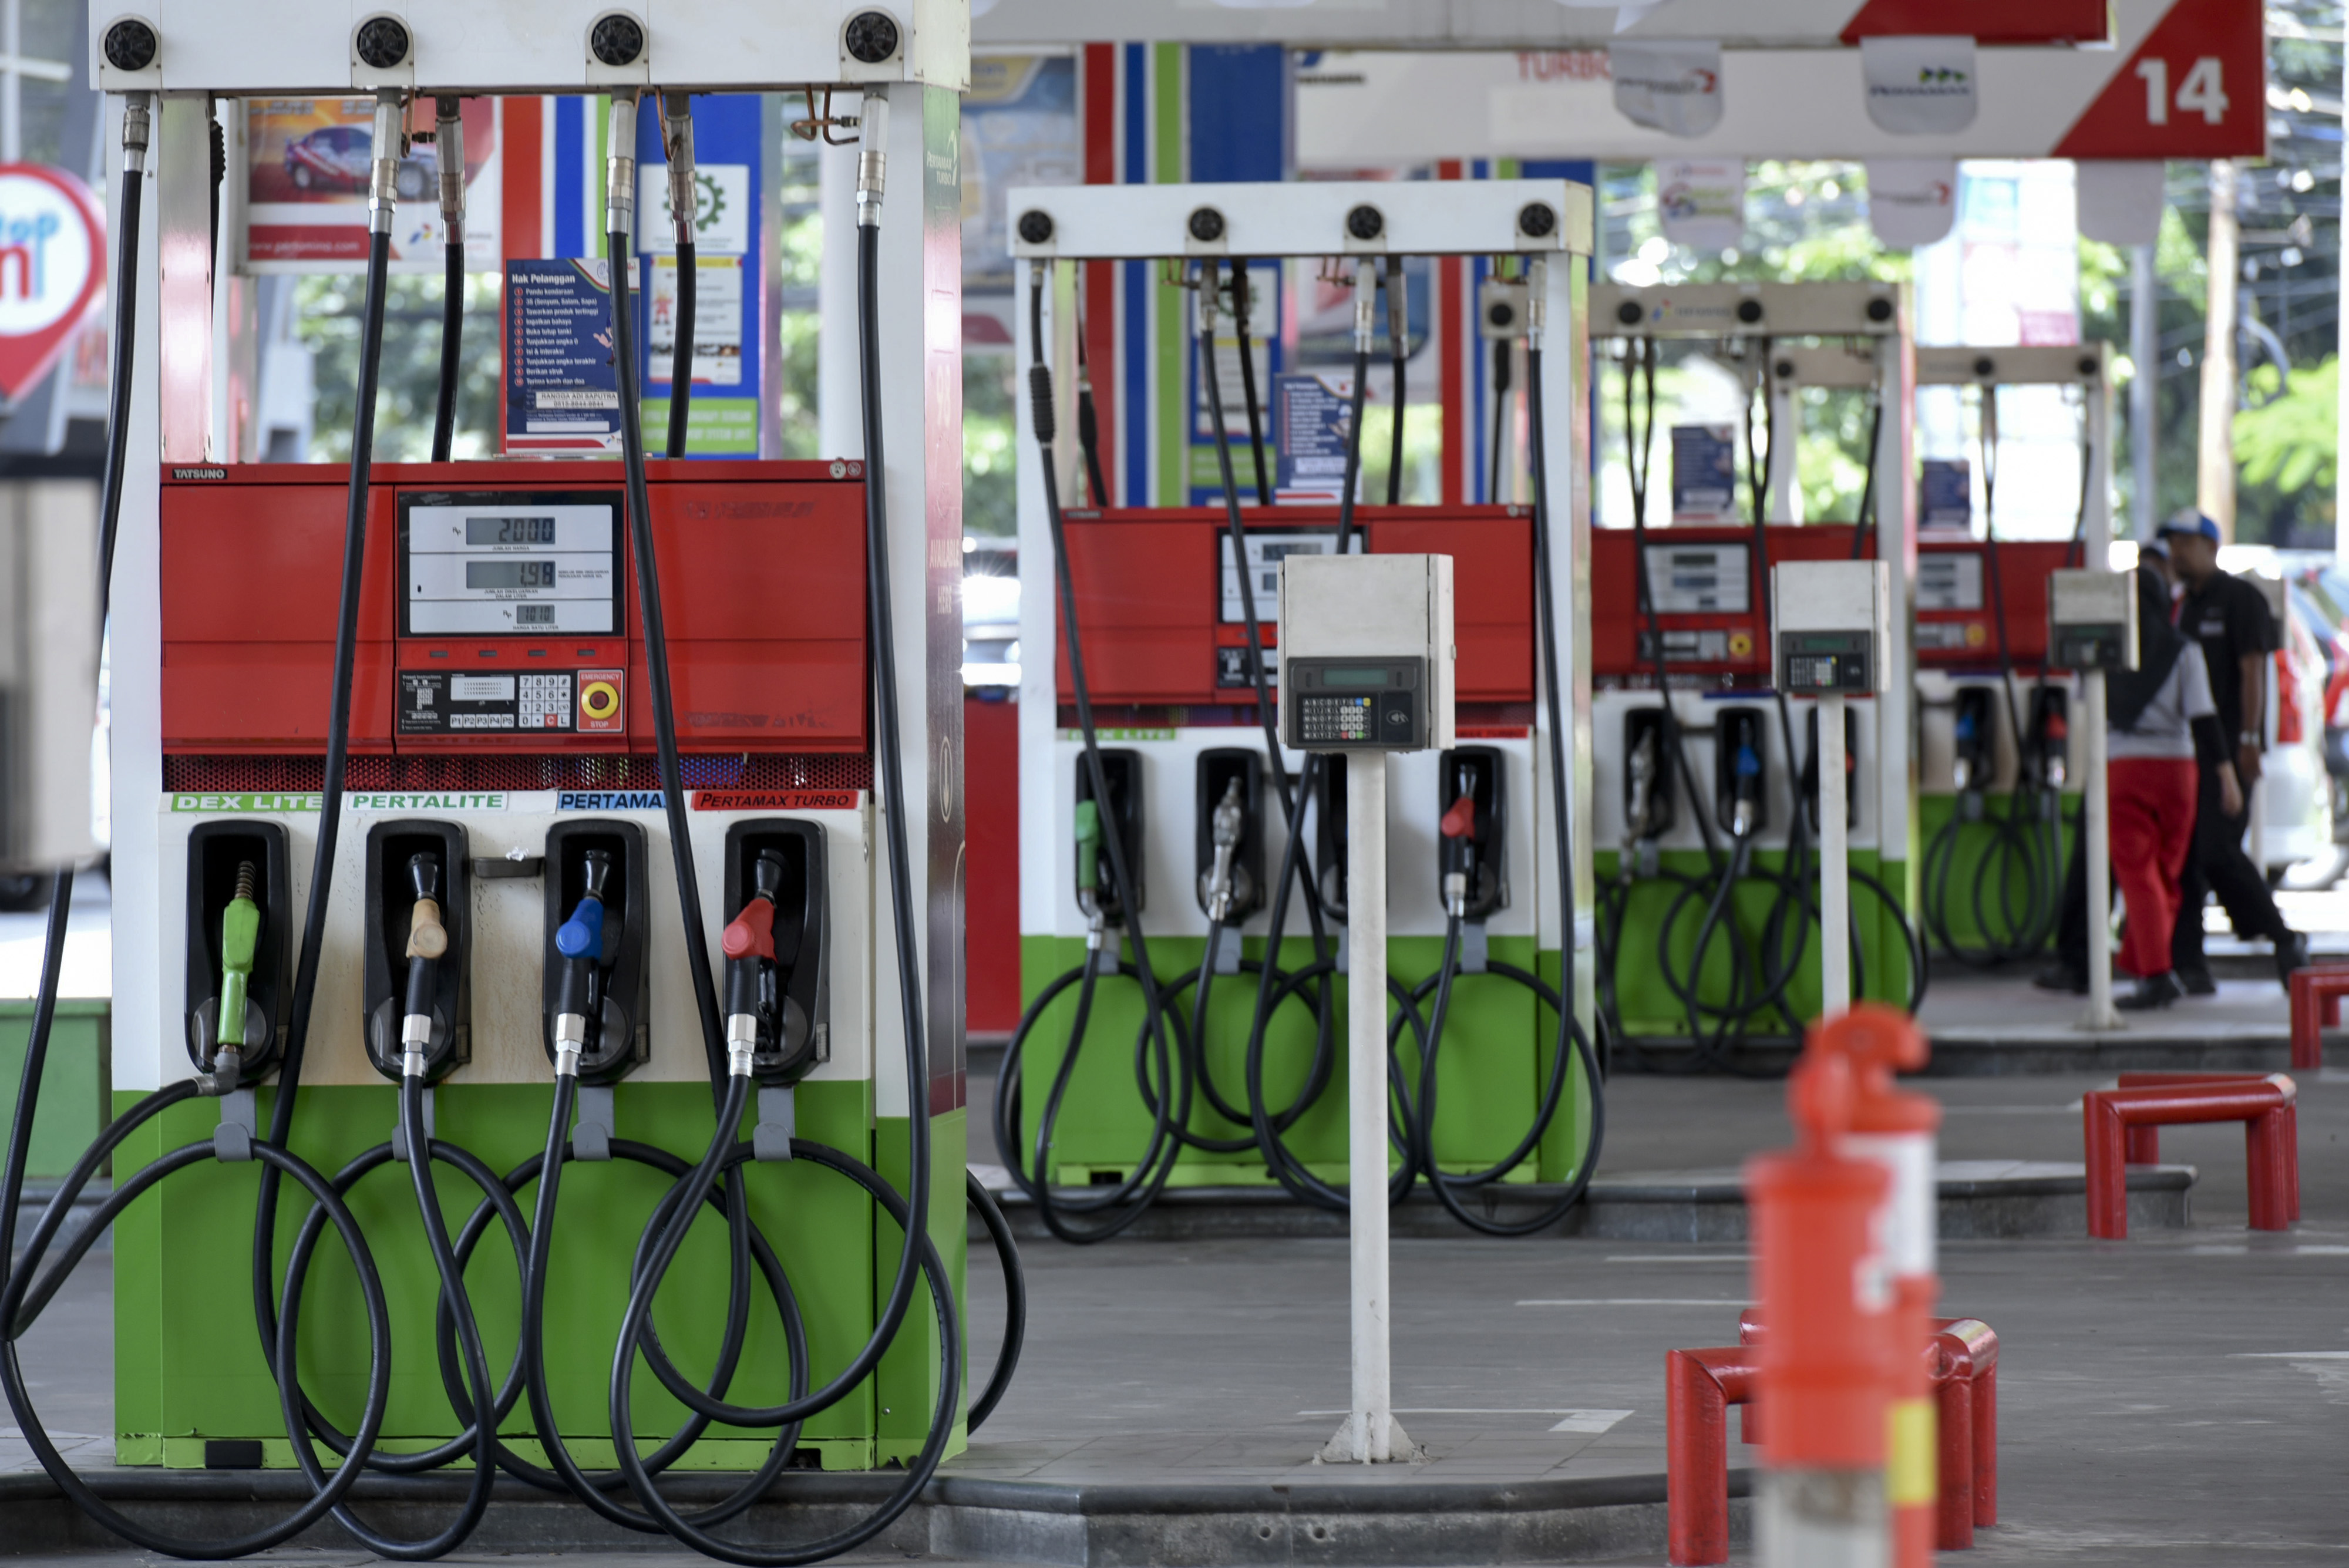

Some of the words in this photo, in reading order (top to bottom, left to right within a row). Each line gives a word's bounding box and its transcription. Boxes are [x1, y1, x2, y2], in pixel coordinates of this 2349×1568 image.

[2134, 56, 2230, 126] 14
[927, 150, 952, 170] PERTAMAX
[937, 170, 951, 186] TURBO
[512, 274, 529, 284] Hak
[530, 274, 576, 286] Pelanggan
[554, 308, 574, 317] produk
[575, 308, 598, 317] tertinggi
[526, 318, 551, 327] Ingatkan
[551, 318, 571, 327] bahaya
[526, 338, 555, 346] Tunjukkan
[556, 338, 573, 346] angka
[526, 358, 555, 366] Tunjukkan
[556, 358, 573, 366] angka
[174, 469, 225, 479] TATSUNO
[452, 527, 462, 537] Rp
[499, 518, 554, 542] 2000
[503, 610, 512, 619] Rp
[523, 678, 529, 686] 7
[536, 678, 541, 686] 8
[549, 678, 554, 686] 9
[523, 691, 529, 699] 4
[536, 691, 541, 699] 5
[548, 691, 554, 699] 6
[523, 716, 529, 724] 0
[547, 716, 554, 725] C
[177, 796, 242, 809] DEX
[253, 796, 323, 809] LITE
[353, 795, 503, 808] PERTALITE
[561, 793, 667, 809] PERTAMA
[701, 793, 788, 807] PERTAMAX
[793, 795, 849, 806] TURBO
